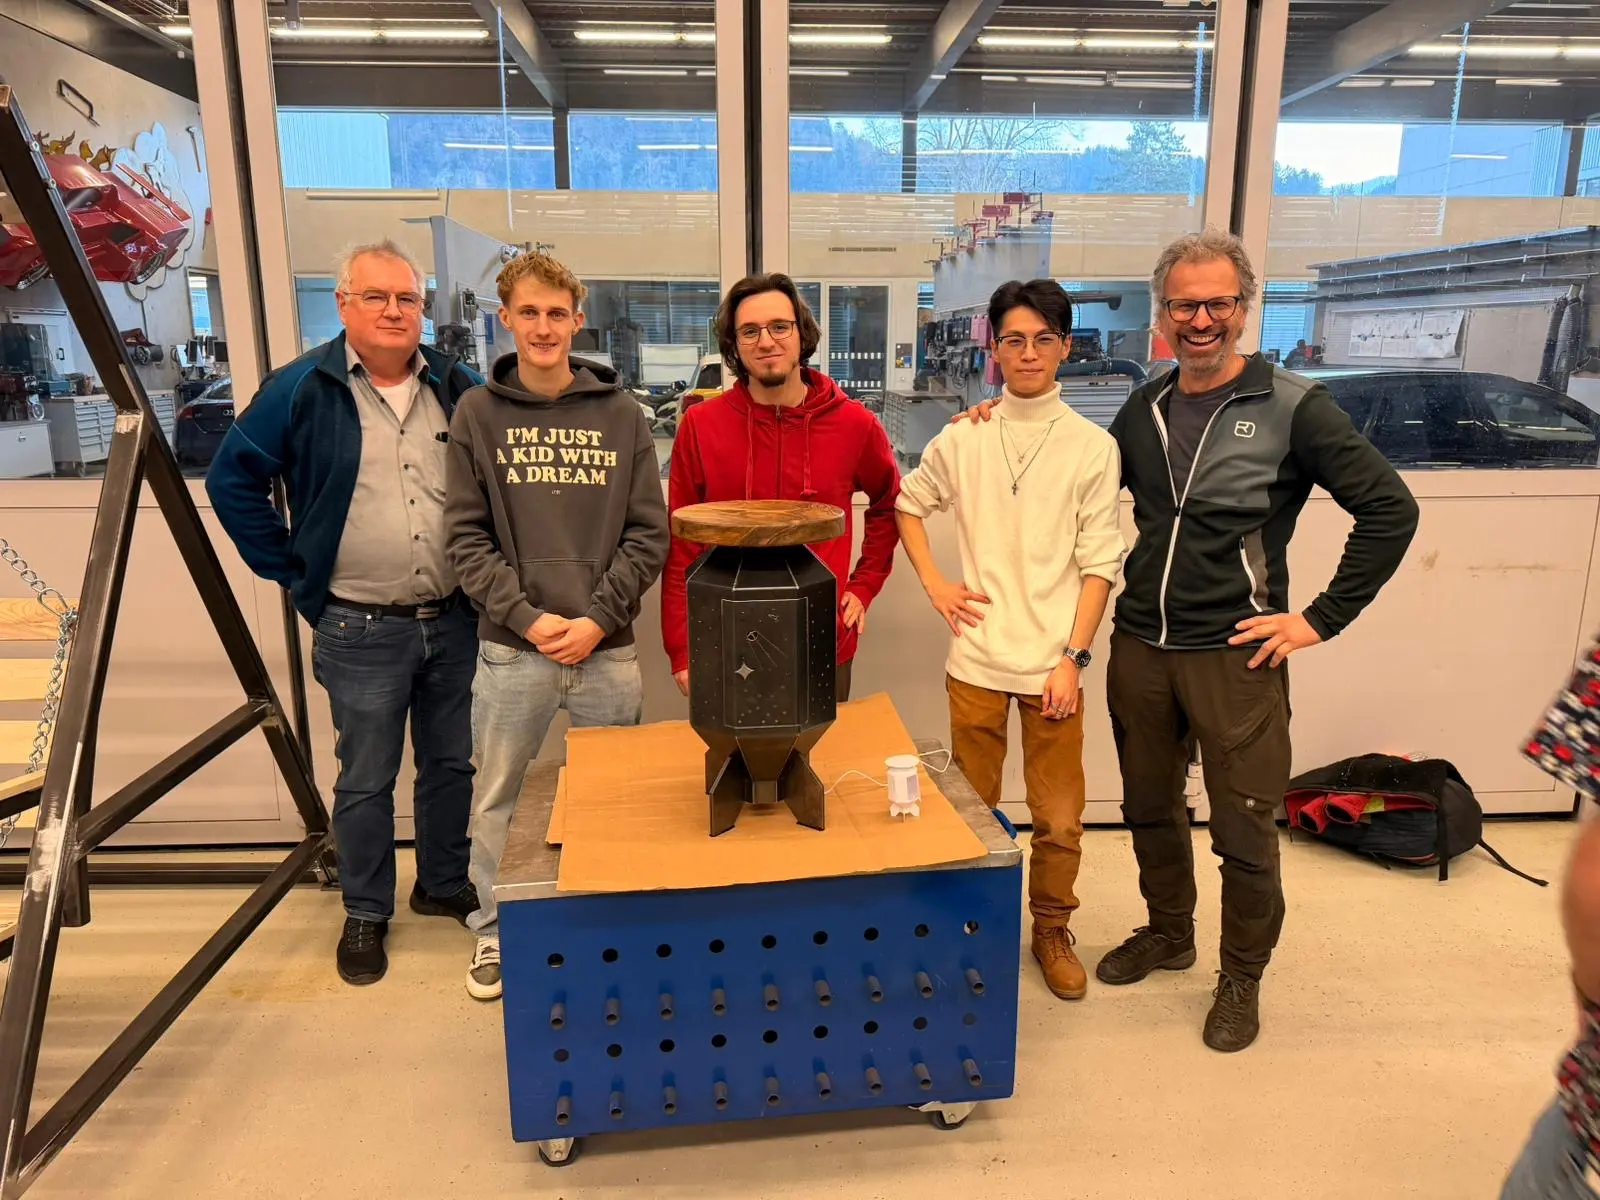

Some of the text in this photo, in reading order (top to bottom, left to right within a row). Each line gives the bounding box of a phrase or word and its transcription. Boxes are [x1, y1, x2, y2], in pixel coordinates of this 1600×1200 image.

[544, 428, 602, 446] JUST
[496, 446, 617, 466] A KID WITH
[506, 466, 606, 485] A DREAM
